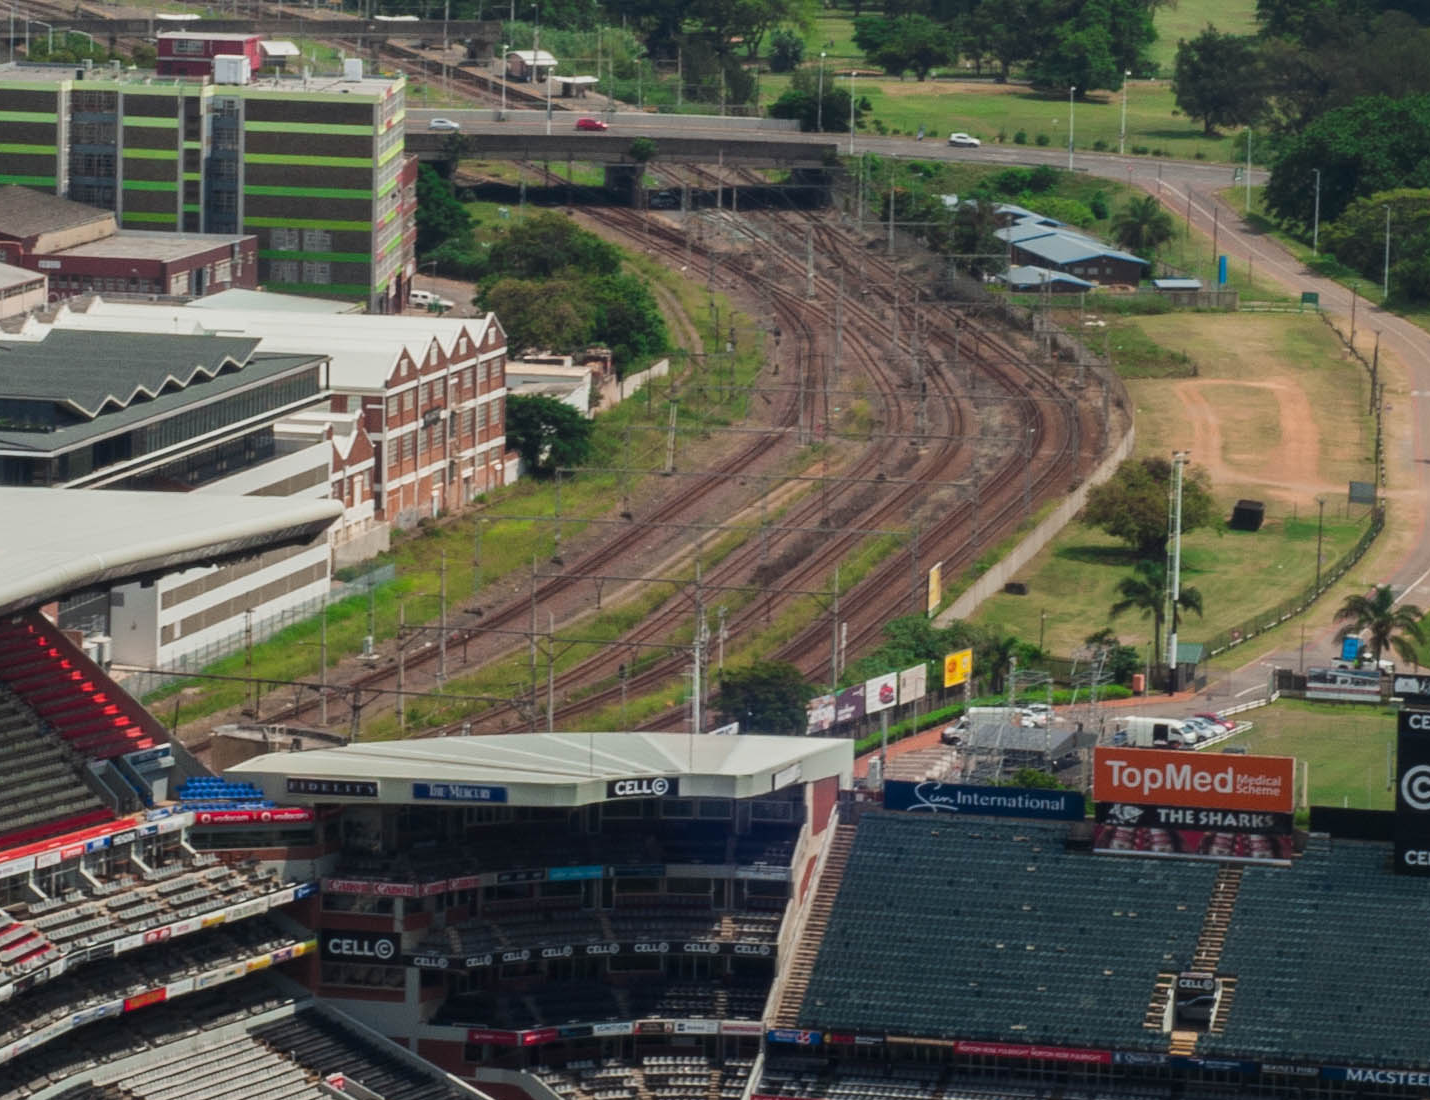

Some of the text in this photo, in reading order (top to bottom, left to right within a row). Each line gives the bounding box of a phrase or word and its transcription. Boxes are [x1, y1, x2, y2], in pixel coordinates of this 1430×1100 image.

[1105, 760, 1233, 795] TopMed
[1236, 773, 1282, 787] Medical
[288, 782, 374, 794] FIDELITY
[1236, 784, 1281, 797] Scheme
[957, 790, 1065, 812] International
[1158, 808, 1273, 829] THE SHARKS
